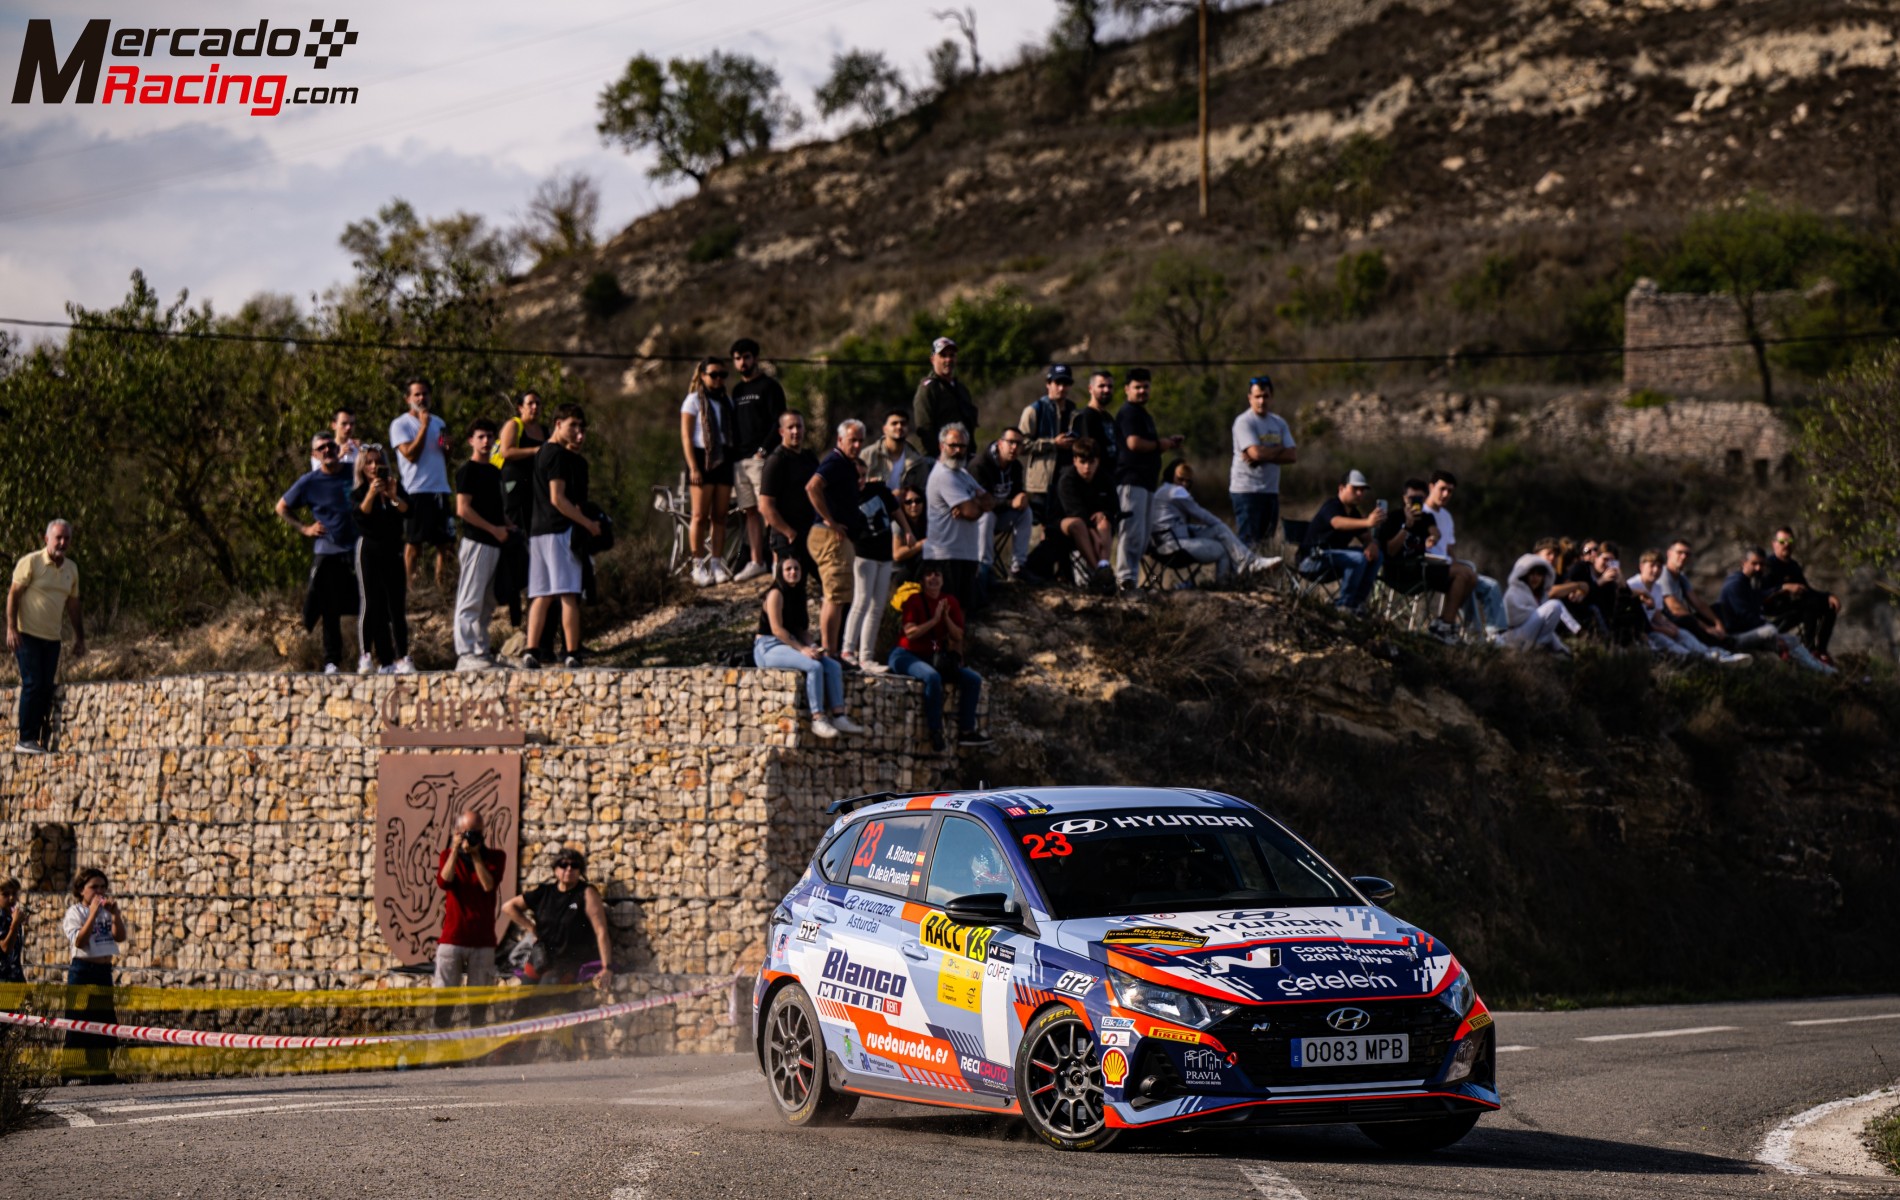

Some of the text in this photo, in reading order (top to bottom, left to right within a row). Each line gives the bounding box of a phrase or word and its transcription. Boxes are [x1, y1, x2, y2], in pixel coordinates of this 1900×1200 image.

[1112, 814, 1254, 828] HYUNDAI
[852, 821, 885, 868] 23
[1022, 832, 1073, 859] 23
[858, 899, 896, 917] HYUNDAI
[846, 914, 881, 934] Asturdai
[925, 915, 965, 952] RACC
[1193, 919, 1343, 934] HYUNDAI
[1241, 928, 1327, 938] Asturdai
[969, 926, 993, 962] 23
[1291, 945, 1338, 954] Copa
[1341, 953, 1393, 964] Rallye
[822, 947, 907, 998] Blanco
[1278, 970, 1398, 995] cetelem
[820, 983, 882, 1011] MOTOR
[886, 1001, 899, 1014] RENT
[1471, 1013, 1491, 1029] PIRELLI
[1152, 1028, 1198, 1043] PIRELLI
[866, 1032, 949, 1064] ruedausada.es
[1306, 1040, 1358, 1063] 0083
[1365, 1038, 1404, 1061] MPB
[1186, 1070, 1221, 1081] PRAVIA
